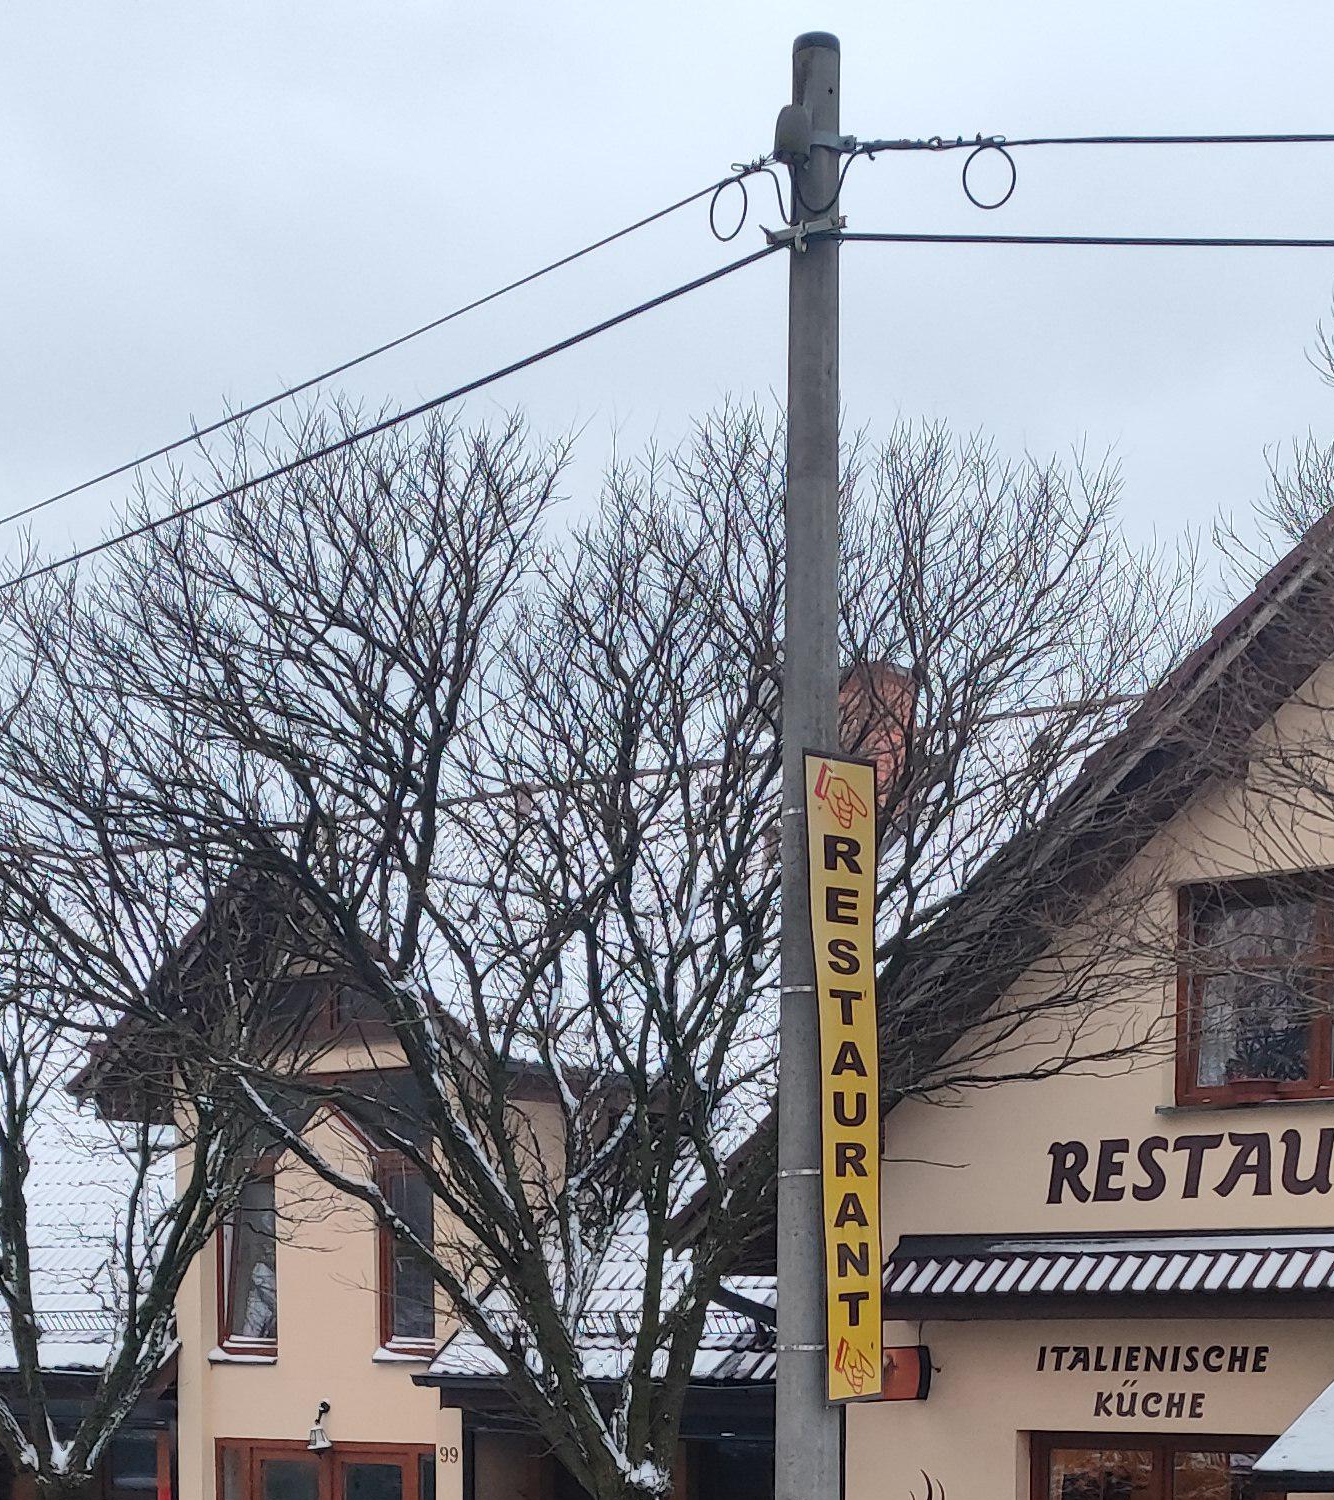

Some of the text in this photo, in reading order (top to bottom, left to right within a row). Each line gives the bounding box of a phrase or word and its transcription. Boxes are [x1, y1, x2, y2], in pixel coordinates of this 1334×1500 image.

[823, 833, 870, 1328] RESTAURANT
[1036, 1344, 1270, 1374] ITALIENISCHE
[1093, 1380, 1206, 1419] KÜCHE
[439, 1446, 459, 1464] 99
